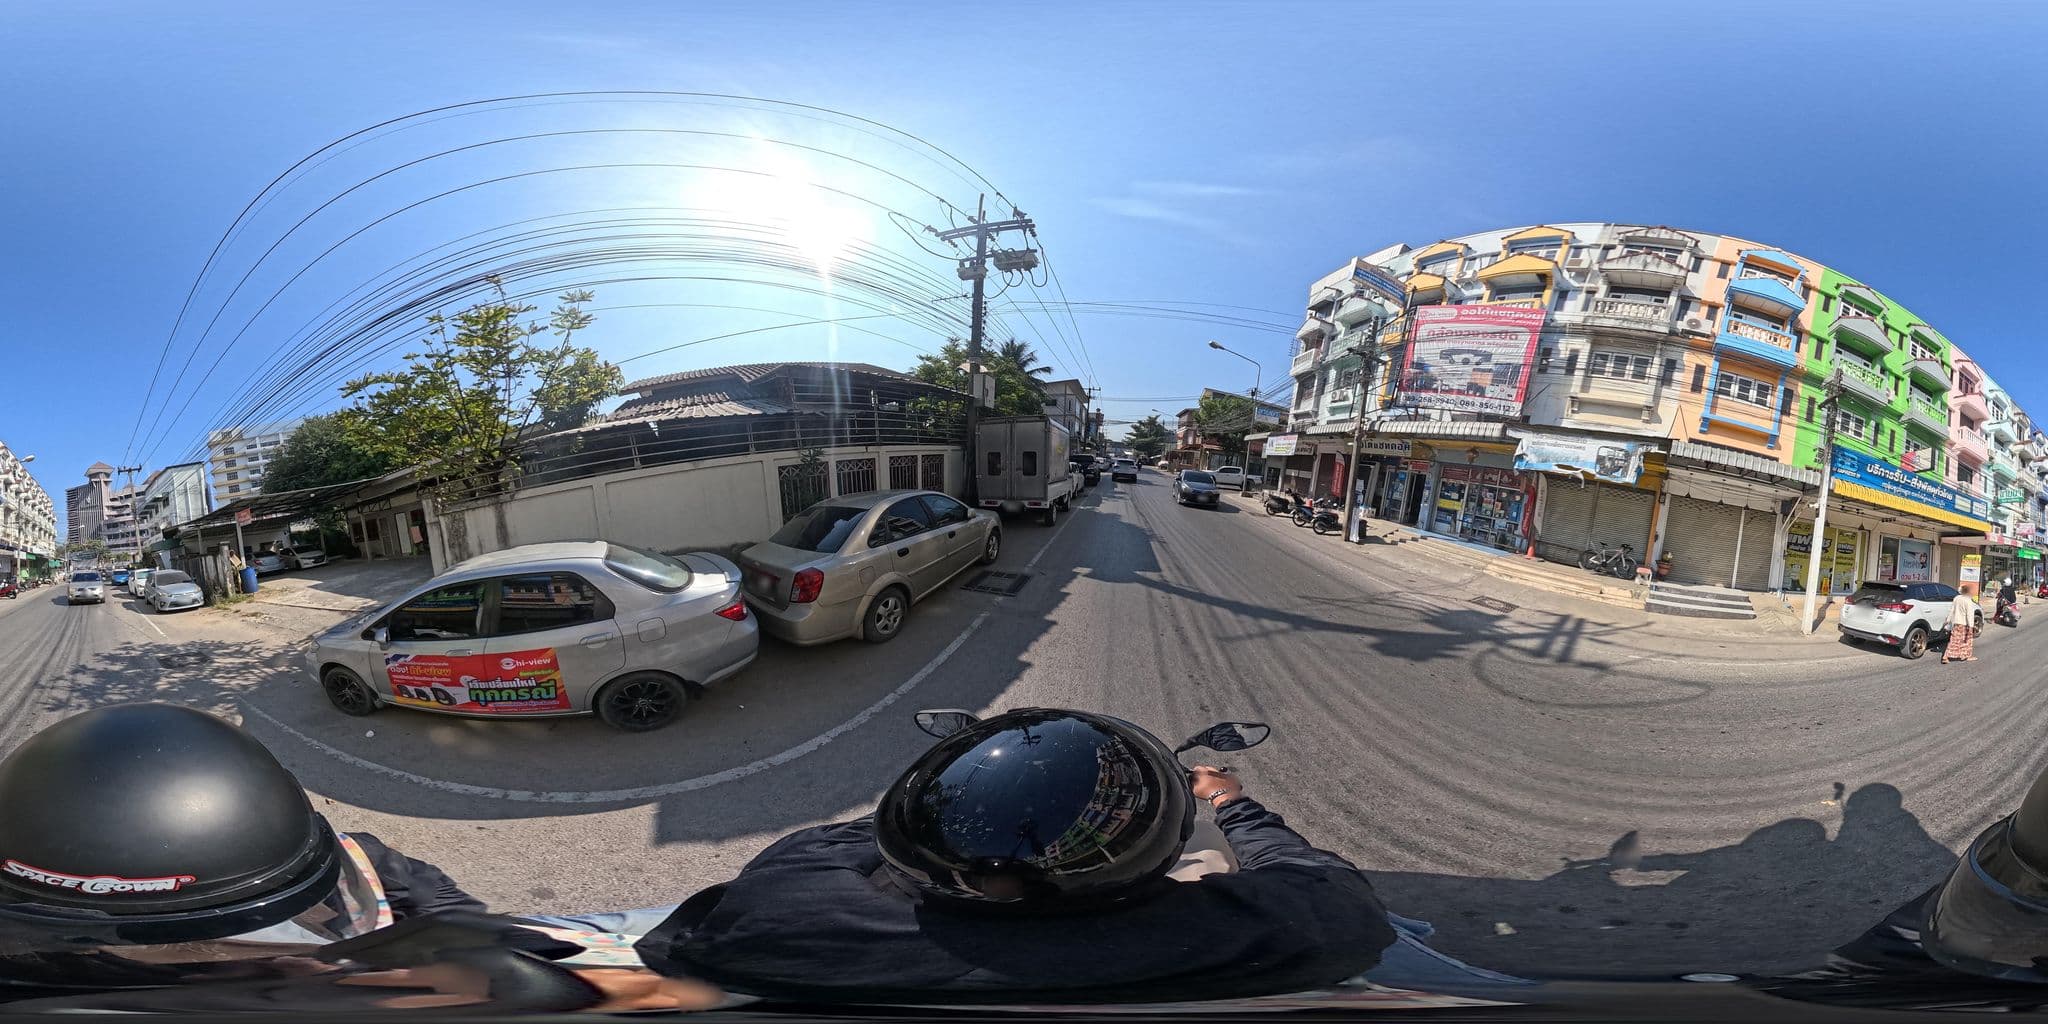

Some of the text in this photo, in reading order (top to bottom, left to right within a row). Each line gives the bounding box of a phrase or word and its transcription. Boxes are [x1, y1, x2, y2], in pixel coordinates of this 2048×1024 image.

[515, 658, 551, 668] hi-view
[470, 680, 556, 706] ทุกกรณี
[3, 861, 81, 889] SPACE
